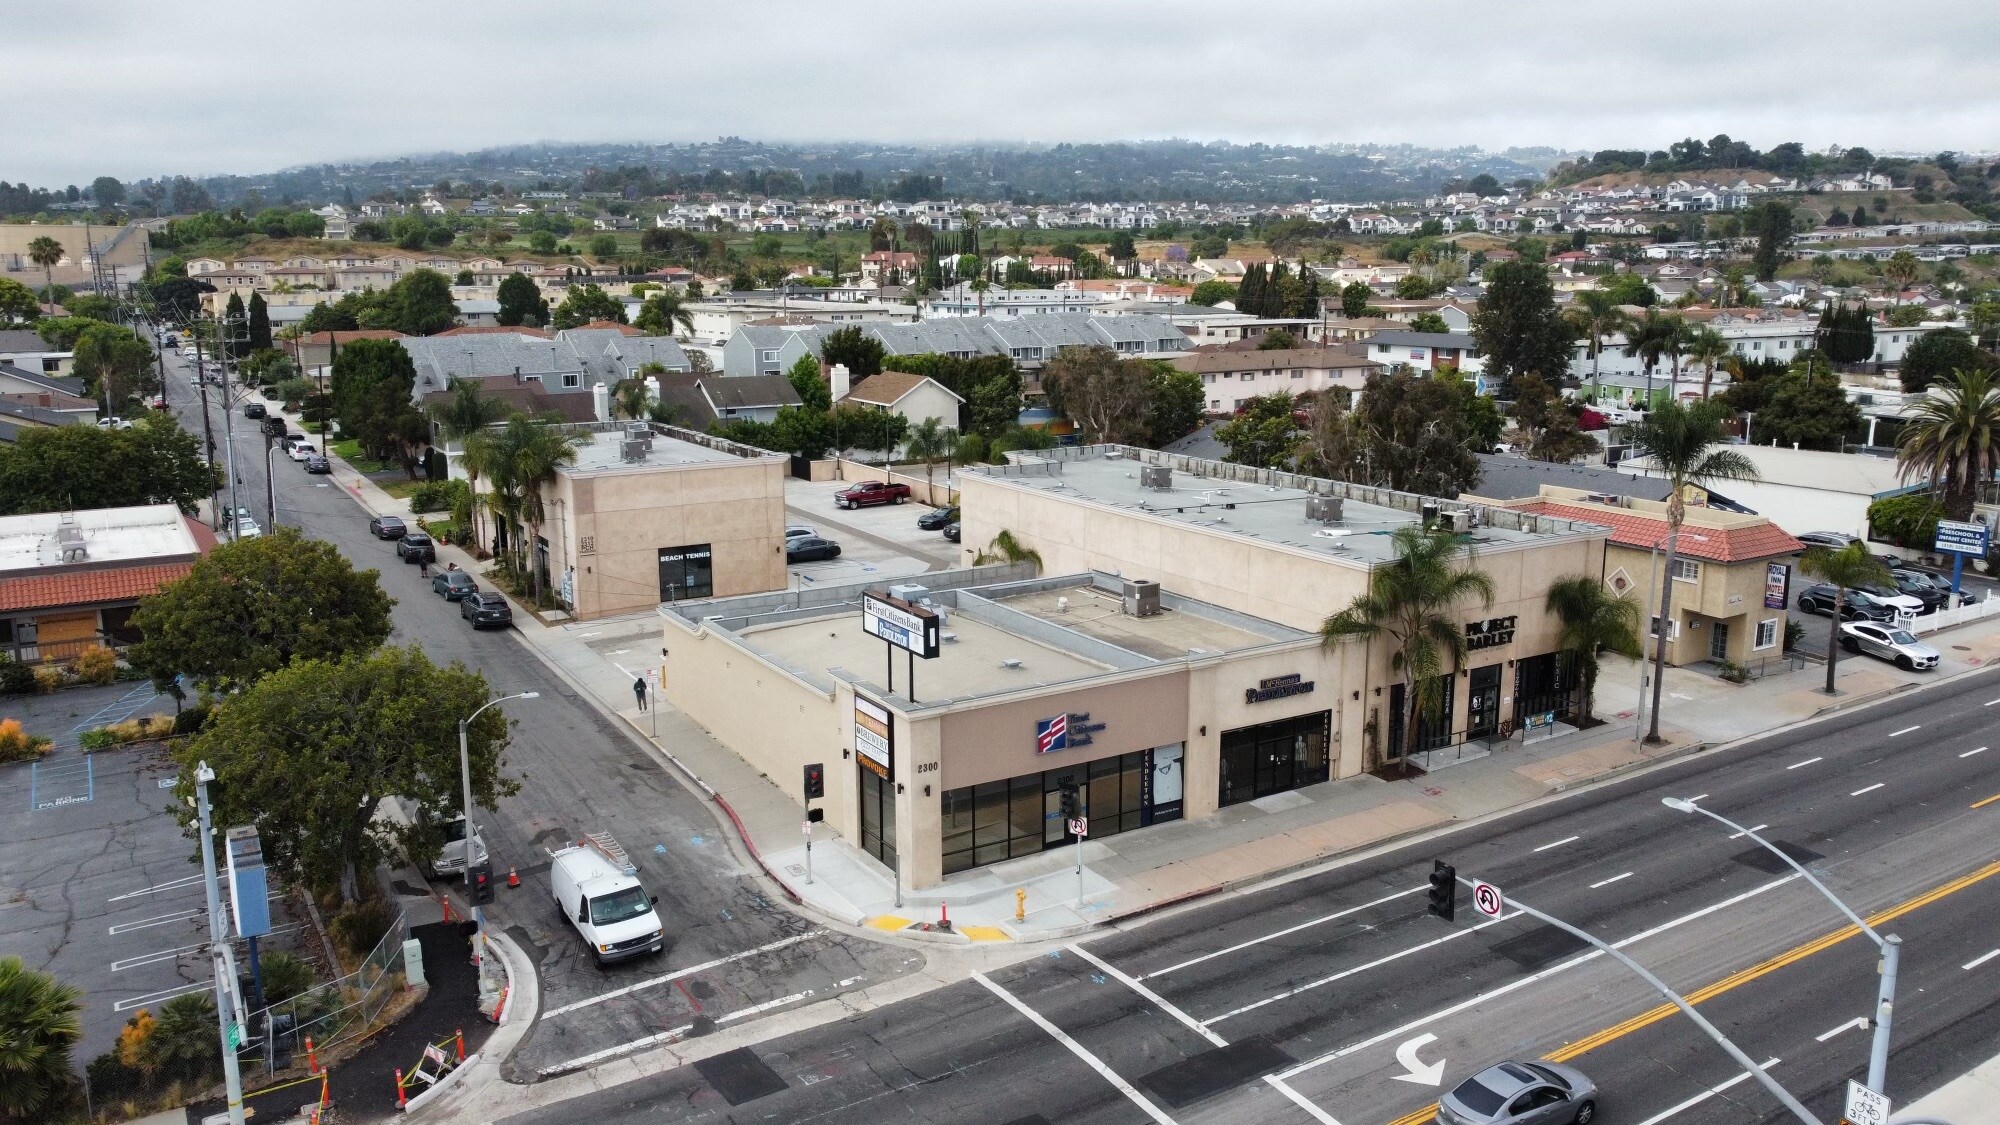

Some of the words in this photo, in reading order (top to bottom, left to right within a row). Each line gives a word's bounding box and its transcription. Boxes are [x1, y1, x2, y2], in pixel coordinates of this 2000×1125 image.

[1938, 534, 1960, 542] INFANT
[1960, 537, 1982, 545] CENTER
[1941, 528, 1974, 538] PRESCHOOL
[660, 554, 684, 562] BEACH
[685, 551, 711, 560] TENNIS
[1768, 564, 1786, 576] ROYAL
[1770, 576, 1782, 585] INN
[1766, 583, 1784, 595] MOTEL
[1466, 630, 1515, 651] BARLEY
[1067, 712, 1090, 724] First
[1067, 722, 1106, 736] Citizens
[860, 725, 888, 752] BREWERY
[1067, 733, 1094, 749] Bank
[859, 753, 888, 779] PROVOKE
[917, 761, 939, 774] 2300
[38, 796, 88, 809] PARKING
[1857, 1087, 1881, 1105] PASS
[1850, 1108, 1857, 1118] 3
[1857, 1114, 1867, 1124] FT
